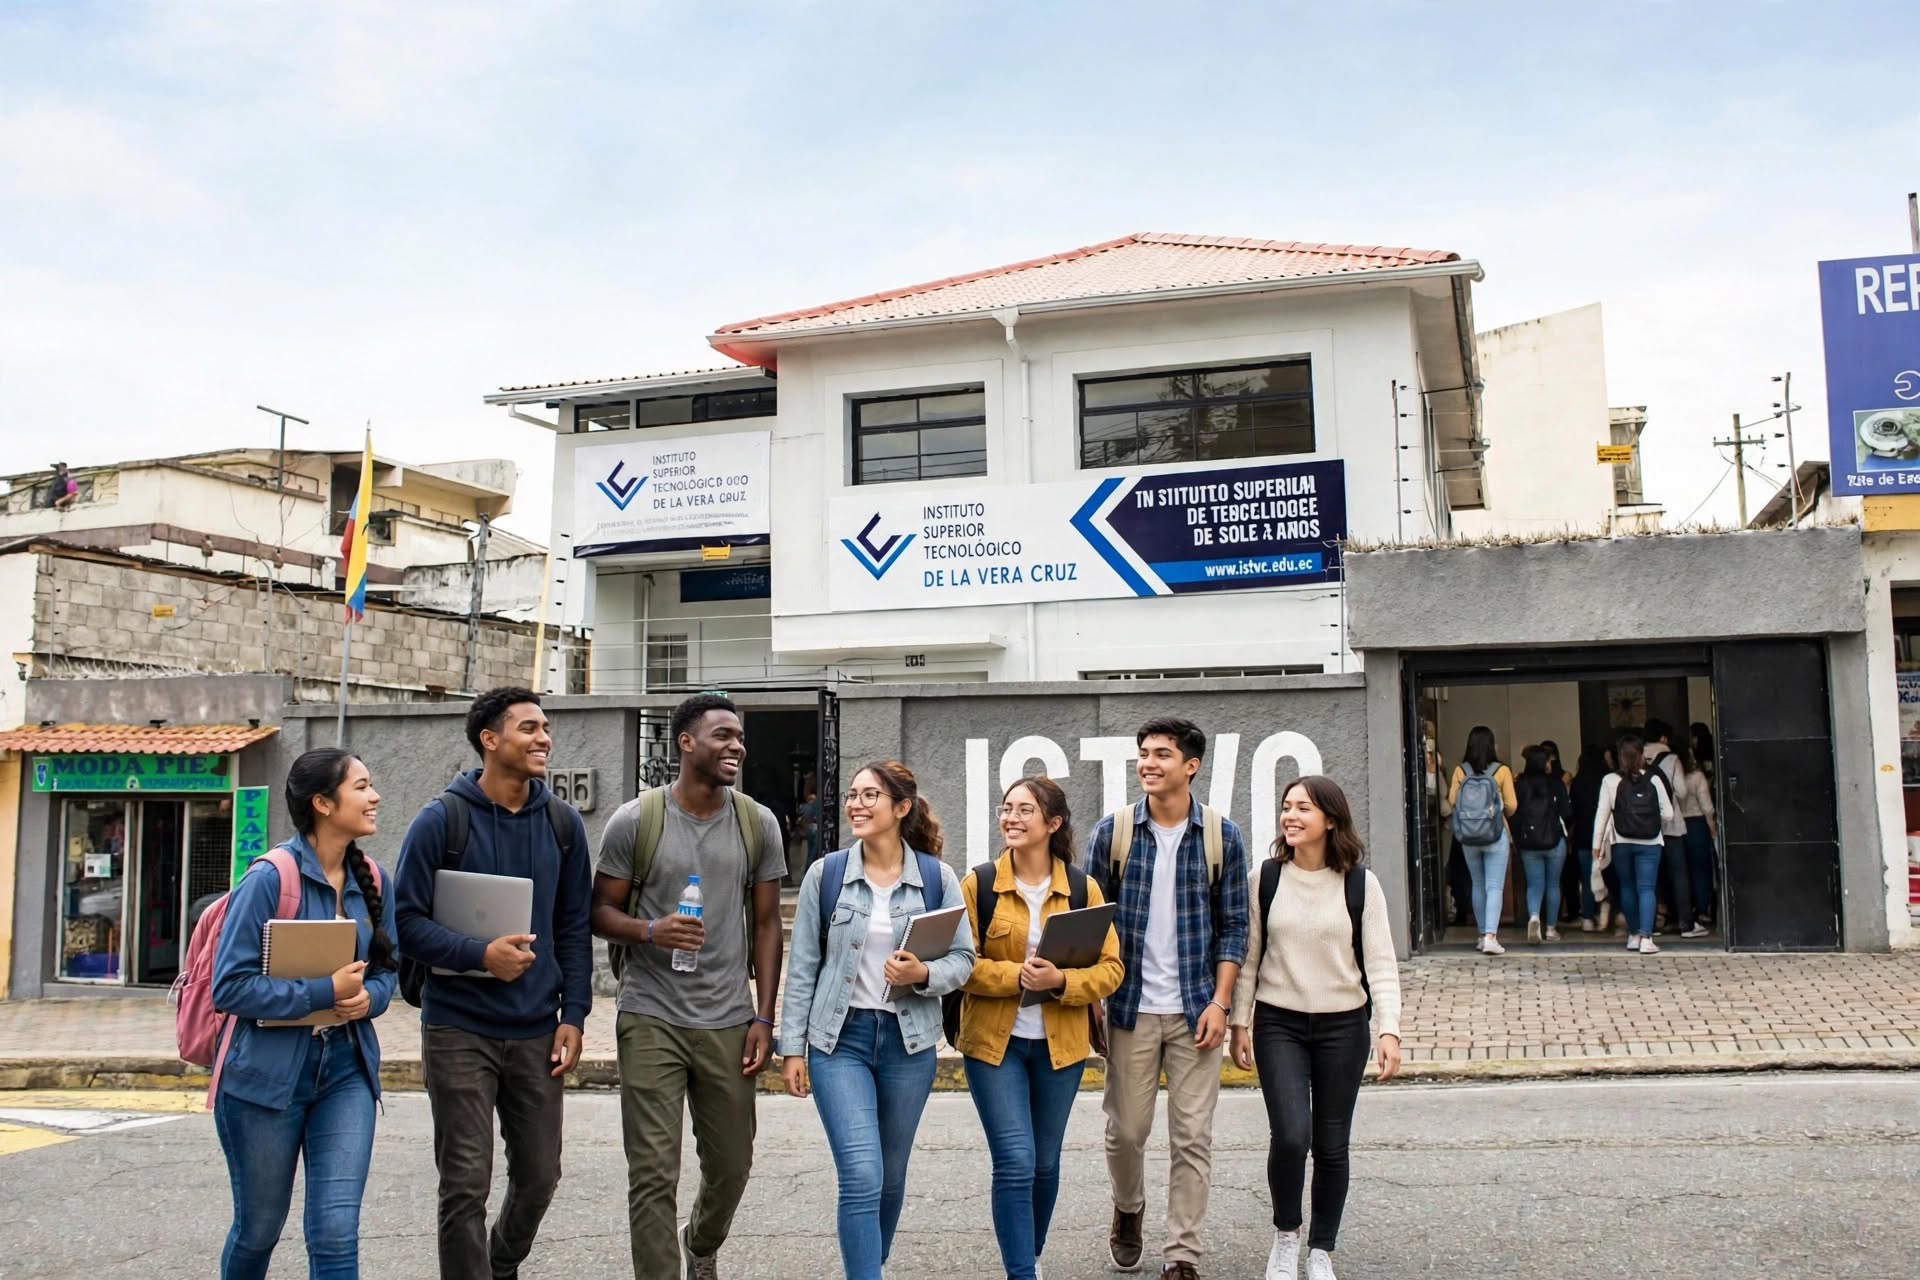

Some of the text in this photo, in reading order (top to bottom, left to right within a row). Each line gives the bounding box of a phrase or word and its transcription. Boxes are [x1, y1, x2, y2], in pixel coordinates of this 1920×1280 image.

[652, 451, 696, 465] INSTITUTO
[653, 465, 696, 478] SUPERIOR
[1878, 473, 1894, 486] de
[653, 498, 666, 509] DE
[670, 497, 683, 508] LA
[687, 494, 714, 506] VERA
[923, 502, 985, 520] INSTITUTO
[1187, 507, 1207, 525] DE
[923, 523, 985, 539] SUPERIOR
[1194, 528, 1214, 546] DE
[924, 563, 1077, 588] DE LA VERA CRUZ
[1205, 557, 1313, 577] www.istvc.edu.ec
[52, 756, 208, 776] MODA PIE
